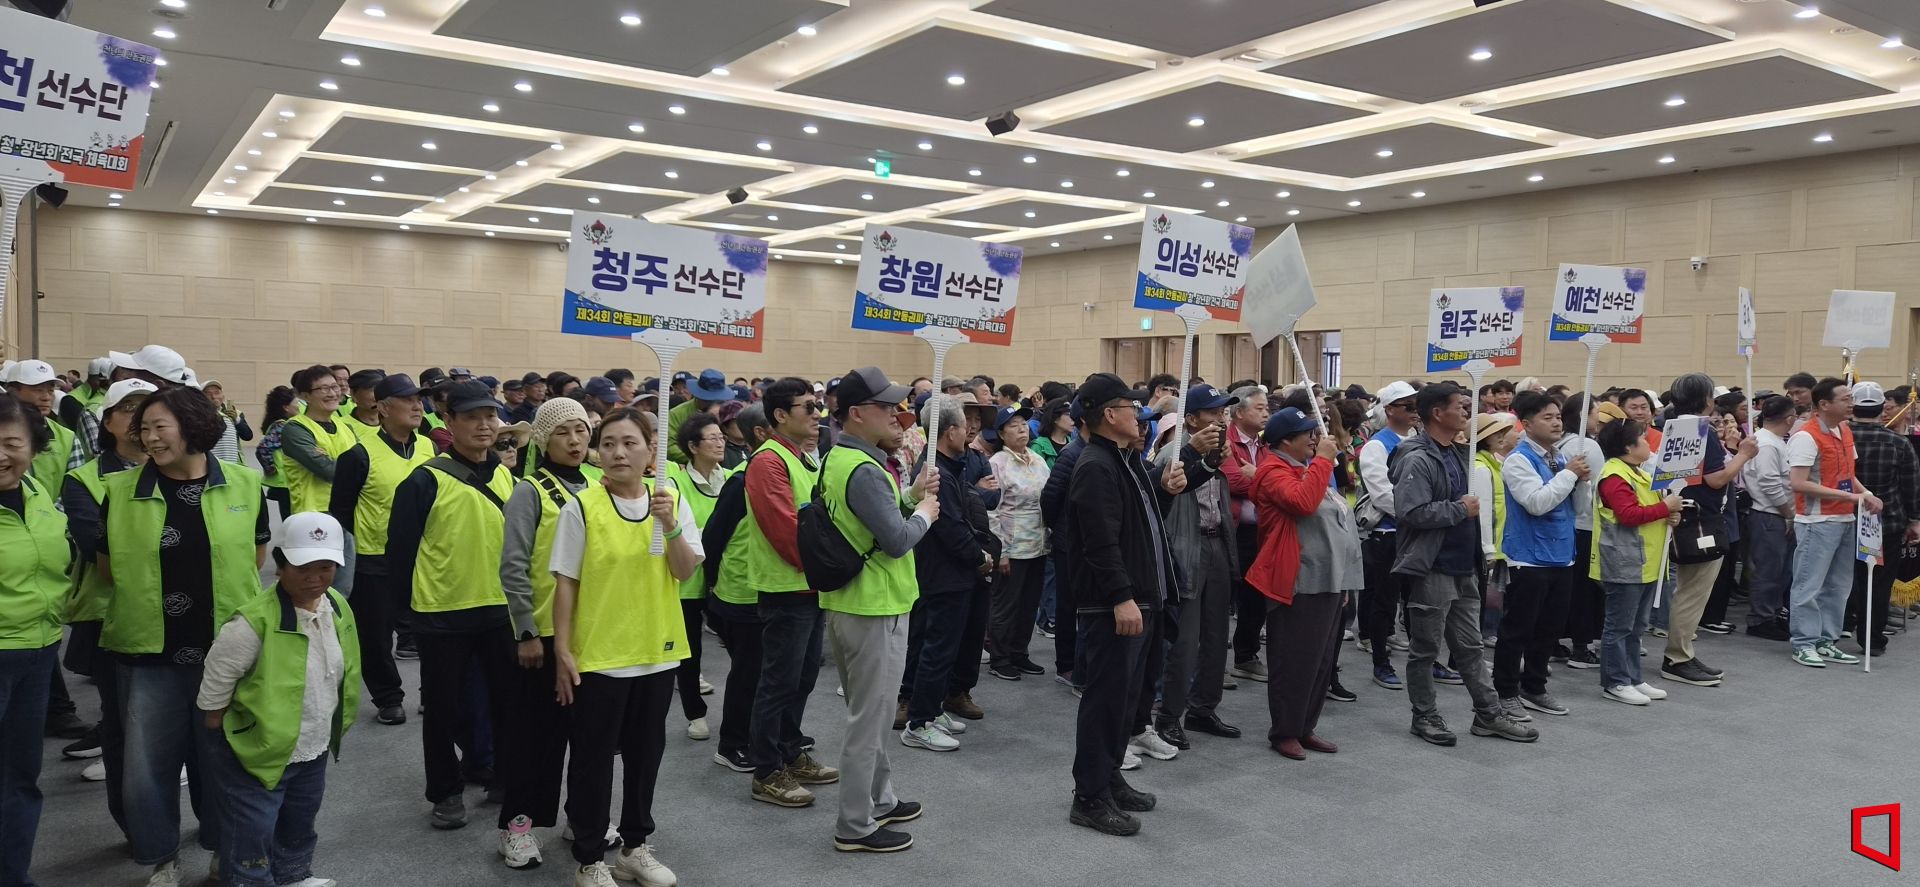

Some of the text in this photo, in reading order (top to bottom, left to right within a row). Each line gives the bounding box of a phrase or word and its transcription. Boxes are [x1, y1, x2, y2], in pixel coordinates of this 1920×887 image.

[37, 69, 128, 122] 선수단
[60, 146, 85, 165] 전국
[86, 151, 129, 171] 체육대회
[1154, 237, 1240, 278] 의성 선수단
[592, 246, 746, 300] 청주 선수단
[878, 255, 1004, 302] 창원 선수단
[1144, 286, 1166, 299] 제34회
[1565, 286, 1636, 314] 예천 선수단
[576, 308, 611, 323] 제34회
[613, 311, 653, 327] 안동권씨
[698, 321, 718, 335] 전국
[719, 323, 755, 338] 체육대회
[864, 306, 892, 320] 제34회
[893, 310, 925, 324] 안동권씨
[961, 317, 977, 330] 전국
[977, 320, 1007, 334] 체육대회
[1440, 310, 1514, 340] 원주 선수단
[1663, 437, 1702, 463] 영덕 선수단
